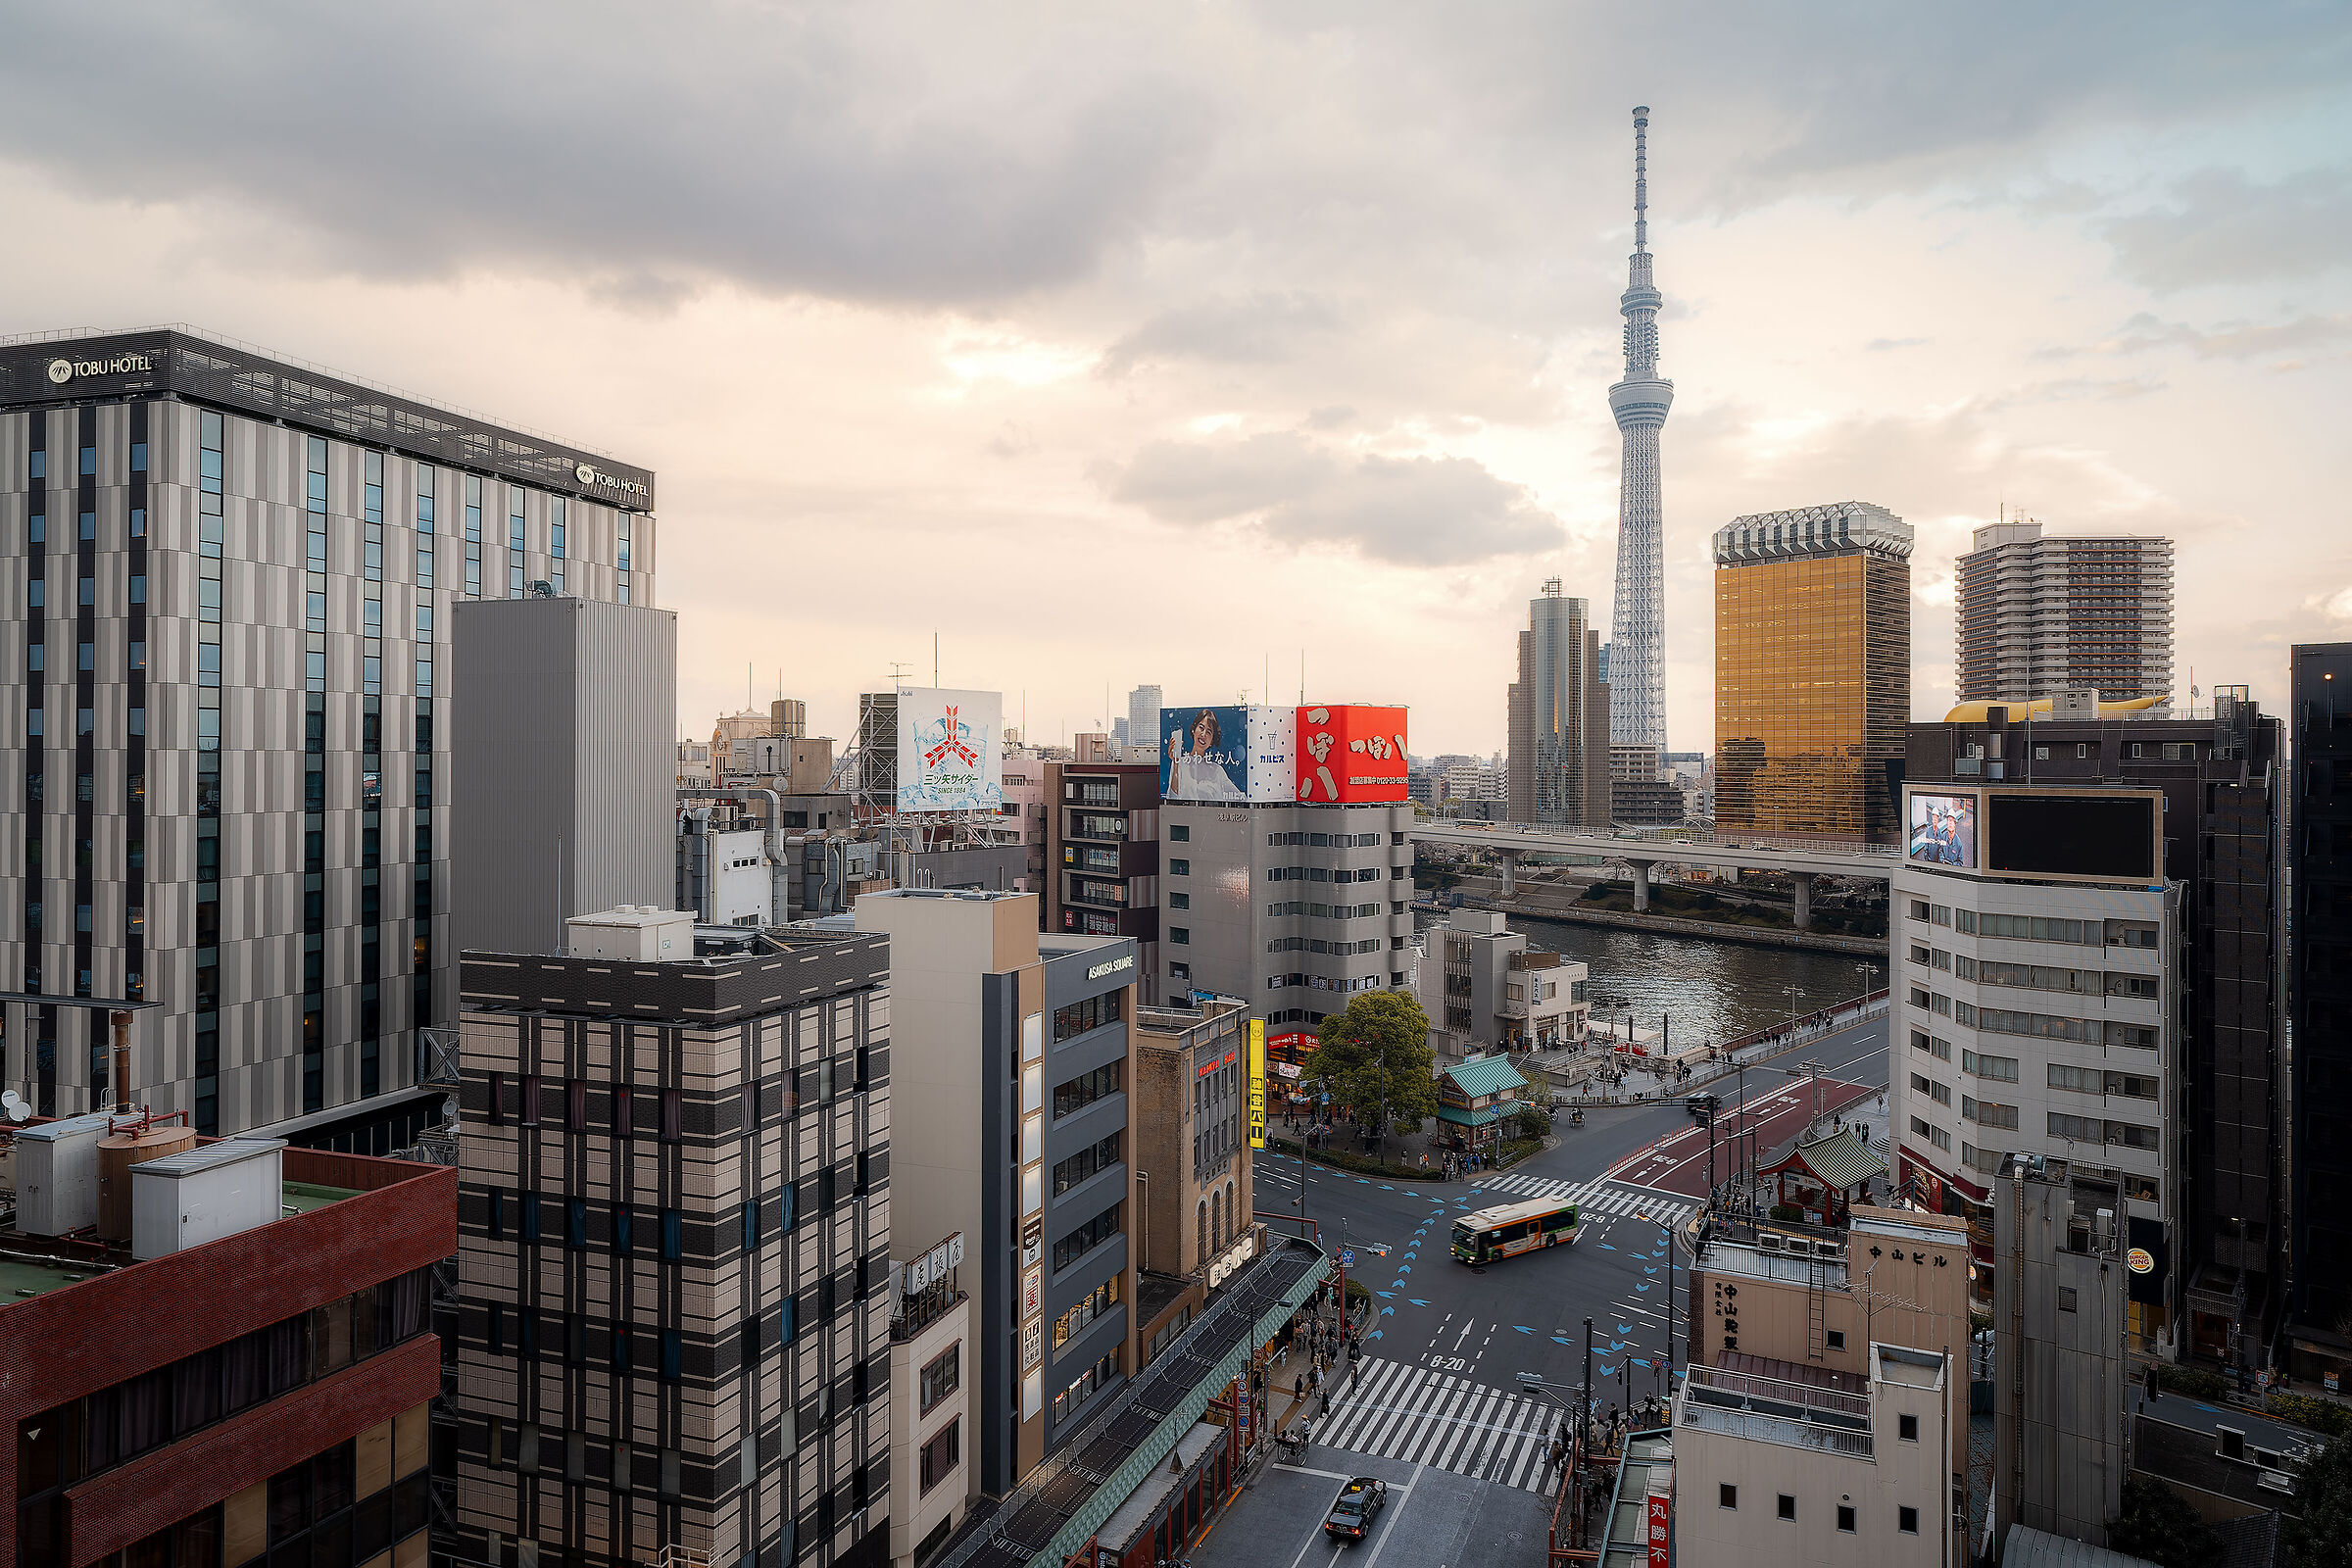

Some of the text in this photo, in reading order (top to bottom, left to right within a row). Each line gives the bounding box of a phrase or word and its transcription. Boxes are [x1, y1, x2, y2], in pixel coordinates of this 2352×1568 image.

[74, 356, 152, 377] TOBU HOTEL
[595, 472, 649, 497] TOBU HOTEL
[1298, 708, 1339, 801] つぼ八
[1349, 734, 1408, 761] つぼ八
[924, 773, 978, 785] 三ツ矢サイダー
[1088, 956, 1134, 981] ASAKUSA SQUARE
[1199, 1051, 1235, 1077] KAMIYA BAR
[1251, 1077, 1262, 1139] 神谷バー
[1651, 1154, 1678, 1165] 8-20
[1579, 1212, 1606, 1224] 8-20
[1869, 1246, 1947, 1267] 中山ビル
[1430, 1354, 1466, 1371] 8-20
[1650, 1502, 1667, 1562] 丸勝不
